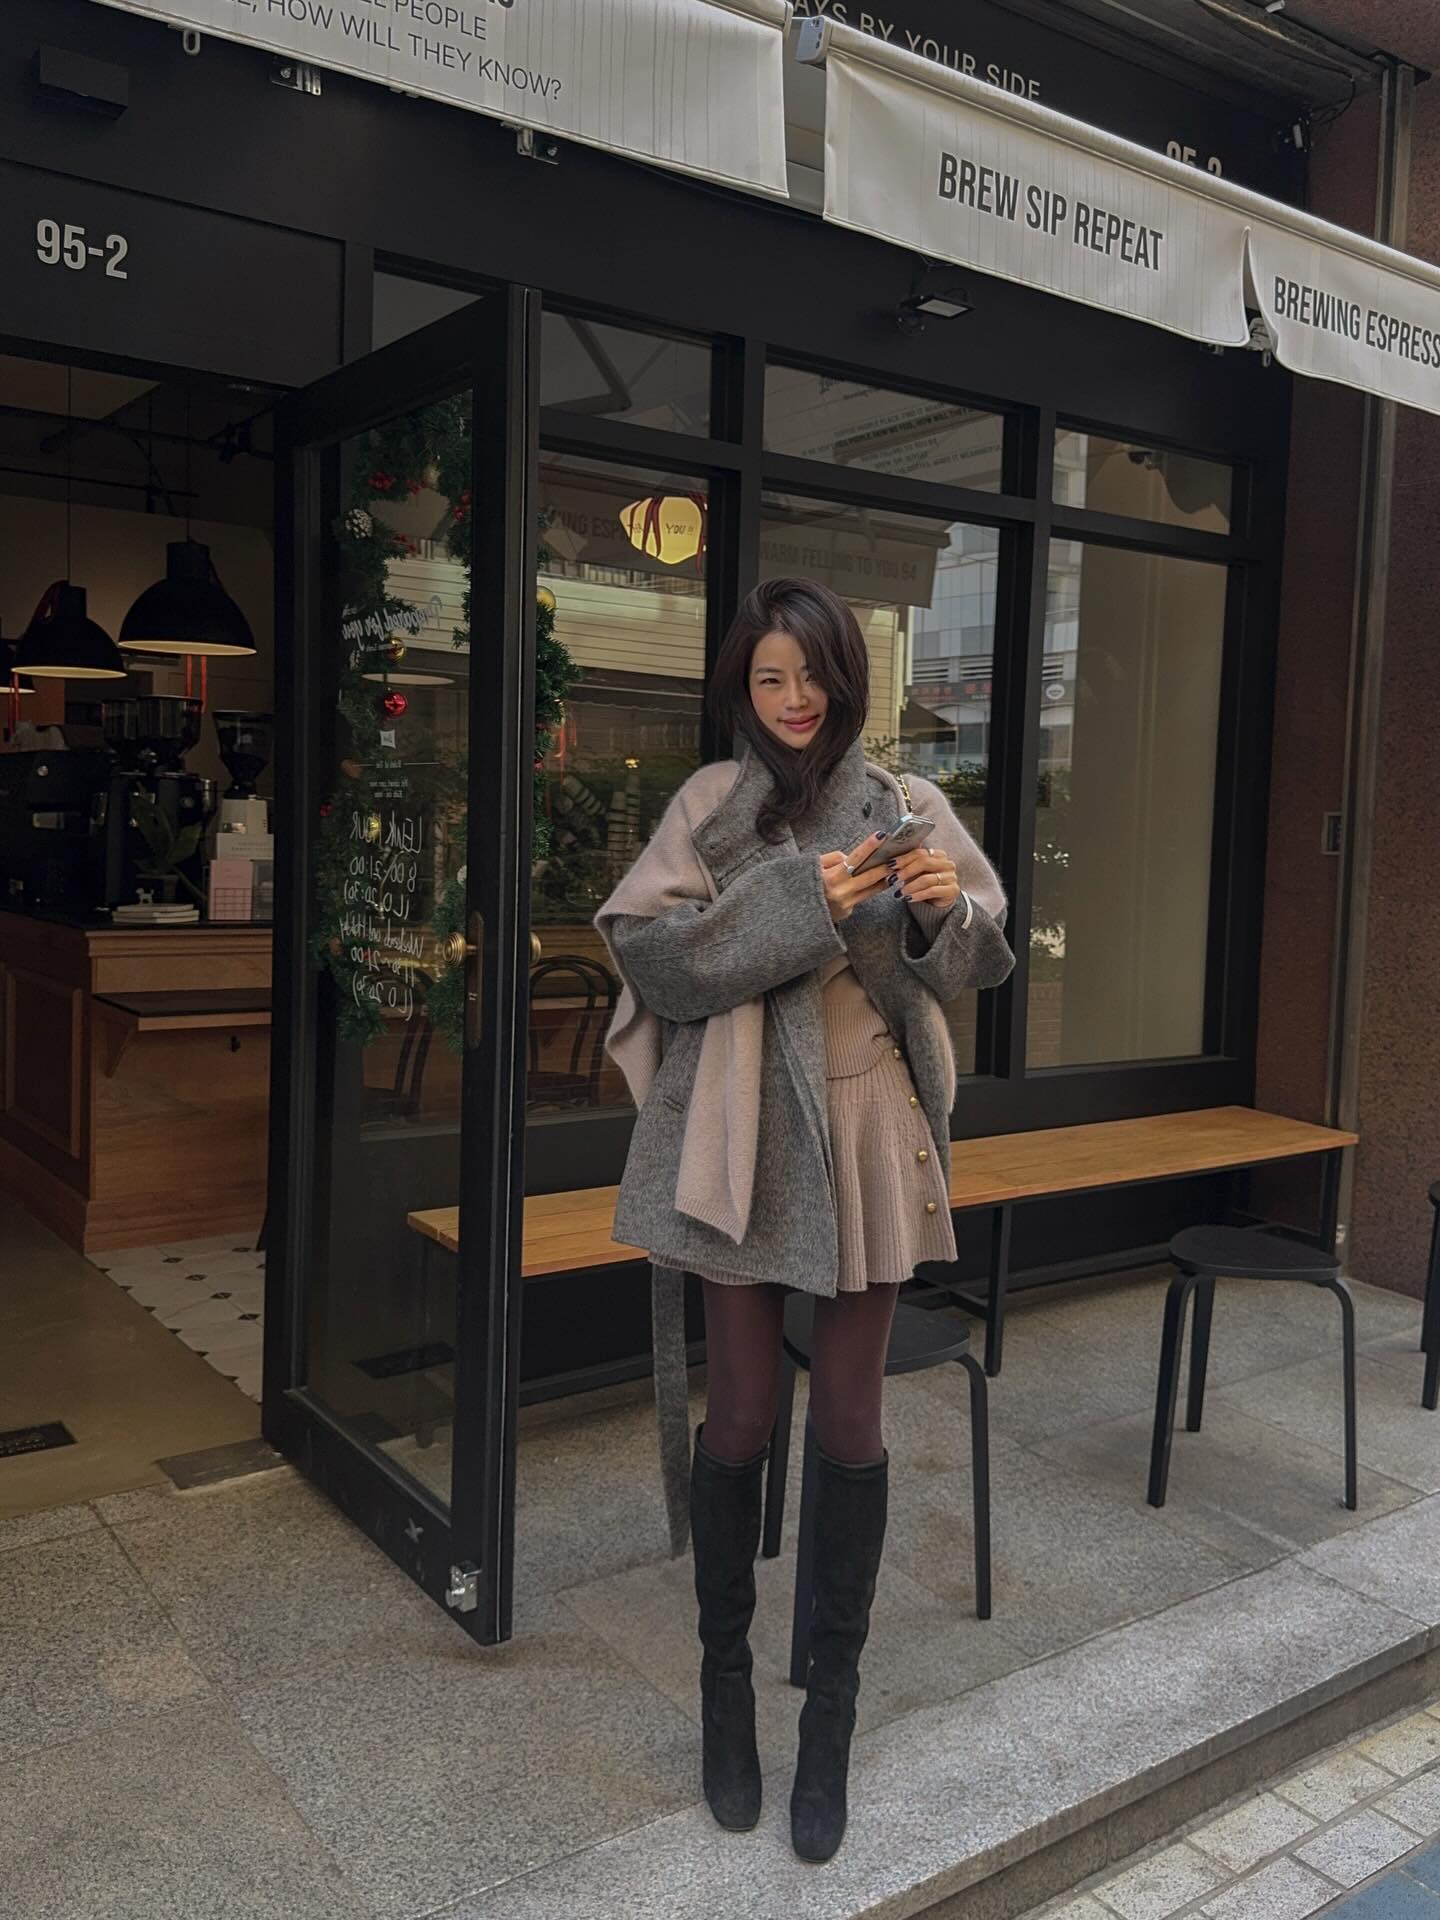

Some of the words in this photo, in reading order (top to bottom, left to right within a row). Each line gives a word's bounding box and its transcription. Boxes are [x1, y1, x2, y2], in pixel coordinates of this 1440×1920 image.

[267, 0, 333, 30] HOW
[340, 11, 400, 51] WILL
[407, 32, 472, 73] THEY
[478, 55, 562, 100] KNOW?
[860, 12, 894, 41] BY
[904, 29, 977, 77] YOUR
[985, 63, 1041, 100] SIDE
[36, 218, 128, 280] 95-2
[938, 151, 1020, 221] BREW
[1025, 184, 1067, 236] SIP
[1073, 201, 1164, 271] REPEAT
[1274, 275, 1361, 341] BREWING
[1365, 309, 1440, 368] ESPRESS
